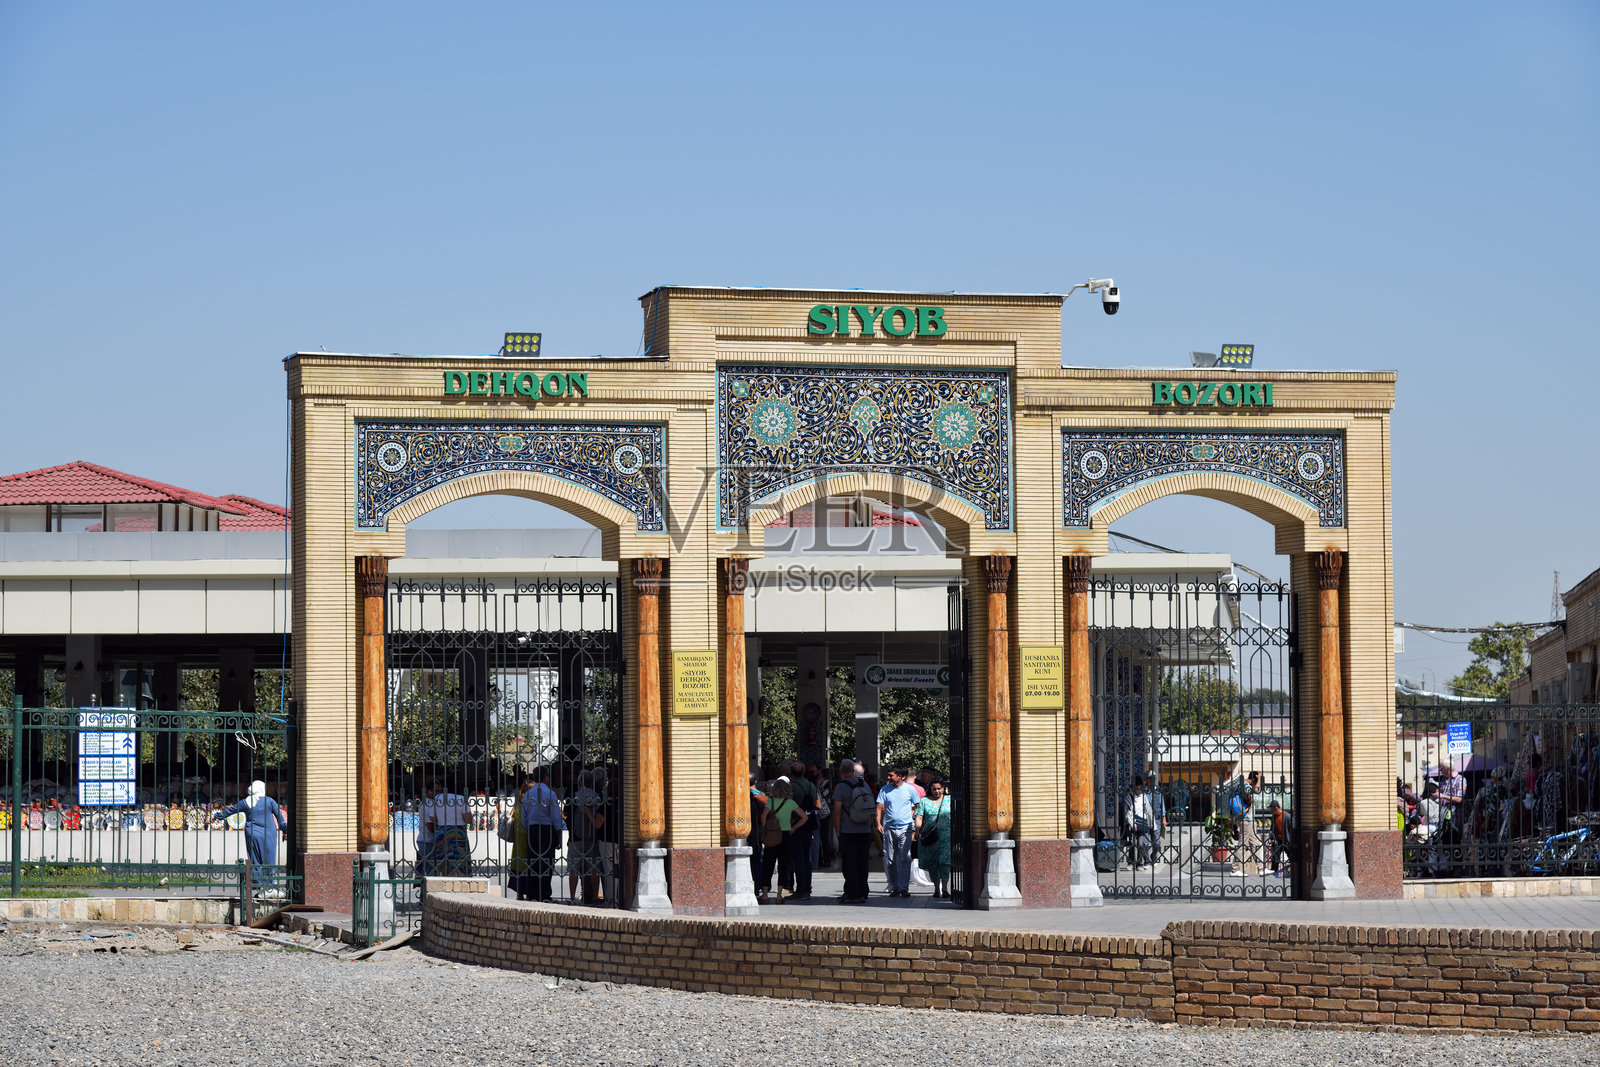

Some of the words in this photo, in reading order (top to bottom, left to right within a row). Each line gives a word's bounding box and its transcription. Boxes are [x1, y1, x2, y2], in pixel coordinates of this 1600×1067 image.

[808, 304, 948, 336] SIYOB
[444, 371, 589, 400] DEHQON
[1152, 381, 1275, 406] BOZORI
